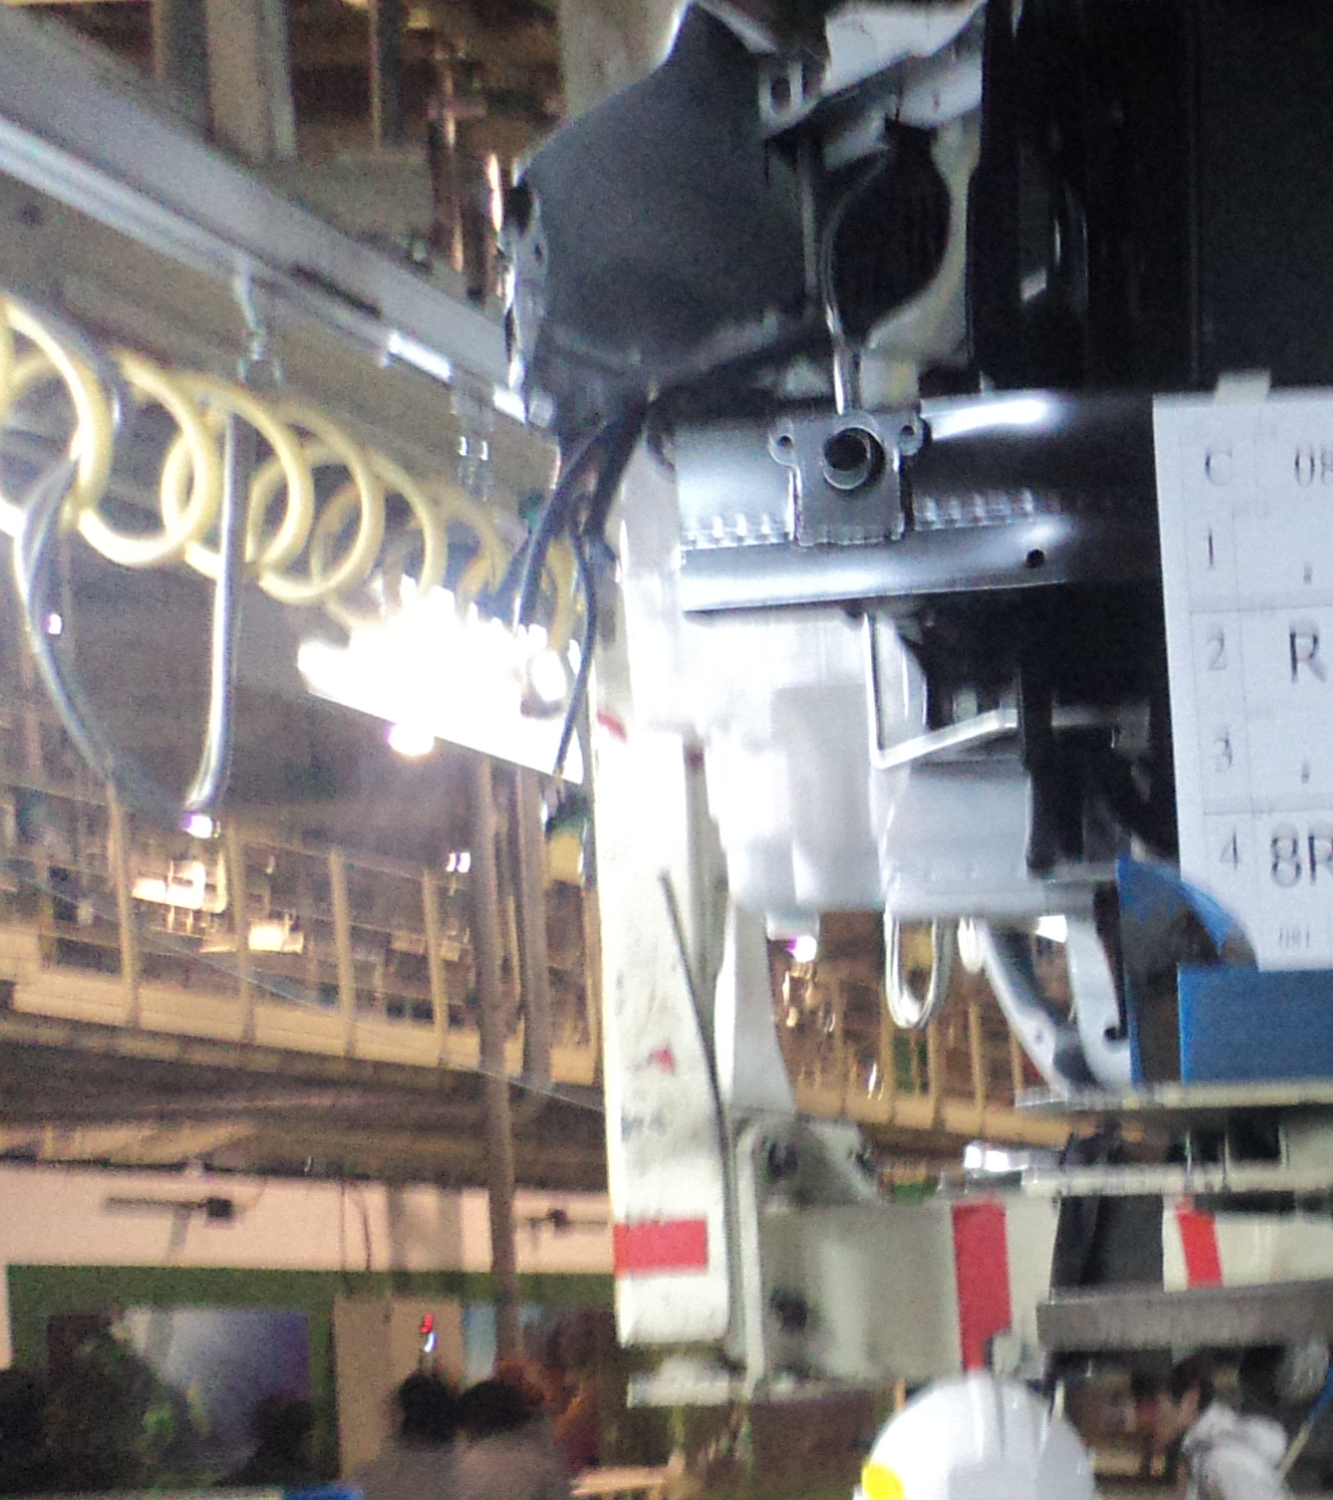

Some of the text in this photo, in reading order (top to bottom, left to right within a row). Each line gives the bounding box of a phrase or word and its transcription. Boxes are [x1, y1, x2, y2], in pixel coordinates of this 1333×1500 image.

[1204, 441, 1234, 487] C
[1205, 623, 1227, 671] 2
[1289, 619, 1327, 683] R
[1212, 723, 1233, 773] 3
[1219, 824, 1240, 871] 4
